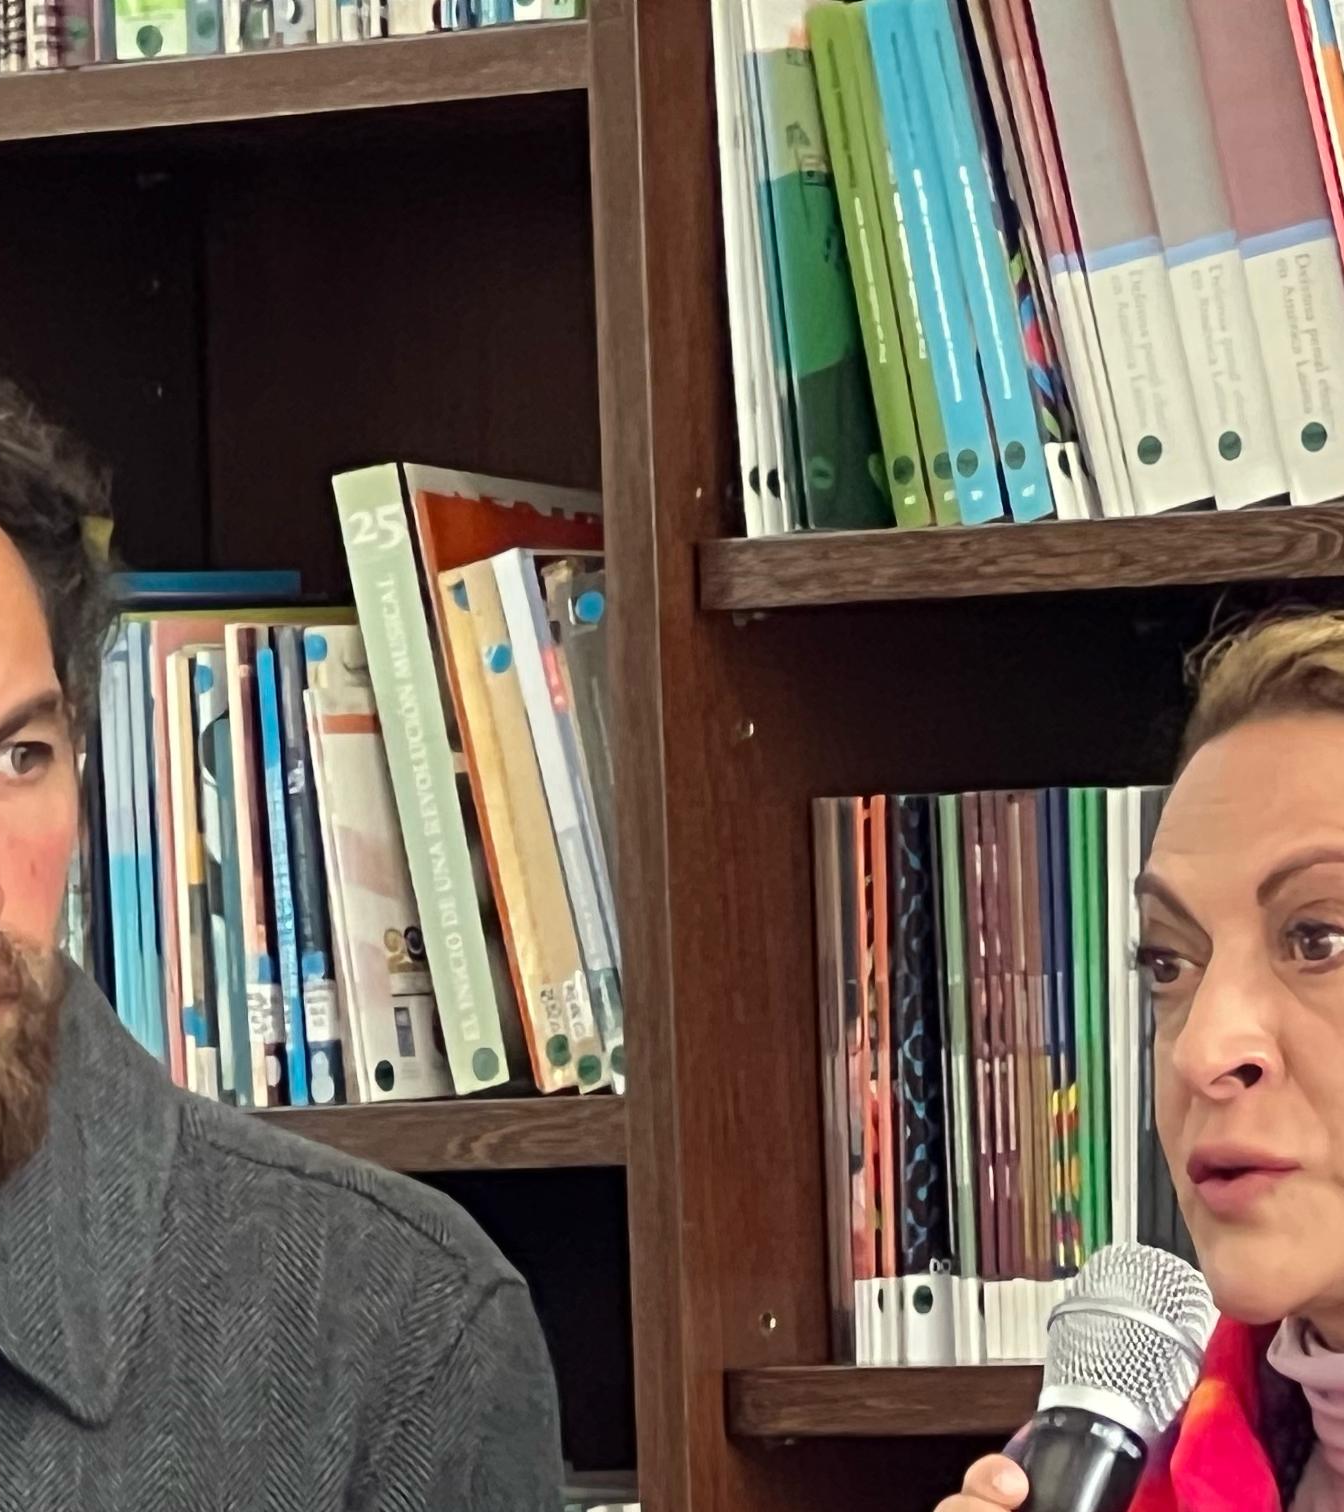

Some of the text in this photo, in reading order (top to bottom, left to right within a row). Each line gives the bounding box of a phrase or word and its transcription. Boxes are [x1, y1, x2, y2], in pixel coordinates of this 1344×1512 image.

[348, 502, 404, 550] 25
[375, 572, 412, 679] MUSICAL
[395, 683, 441, 837] REVOLUCIÓN
[429, 840, 453, 892] UNA
[437, 895, 459, 928] DE
